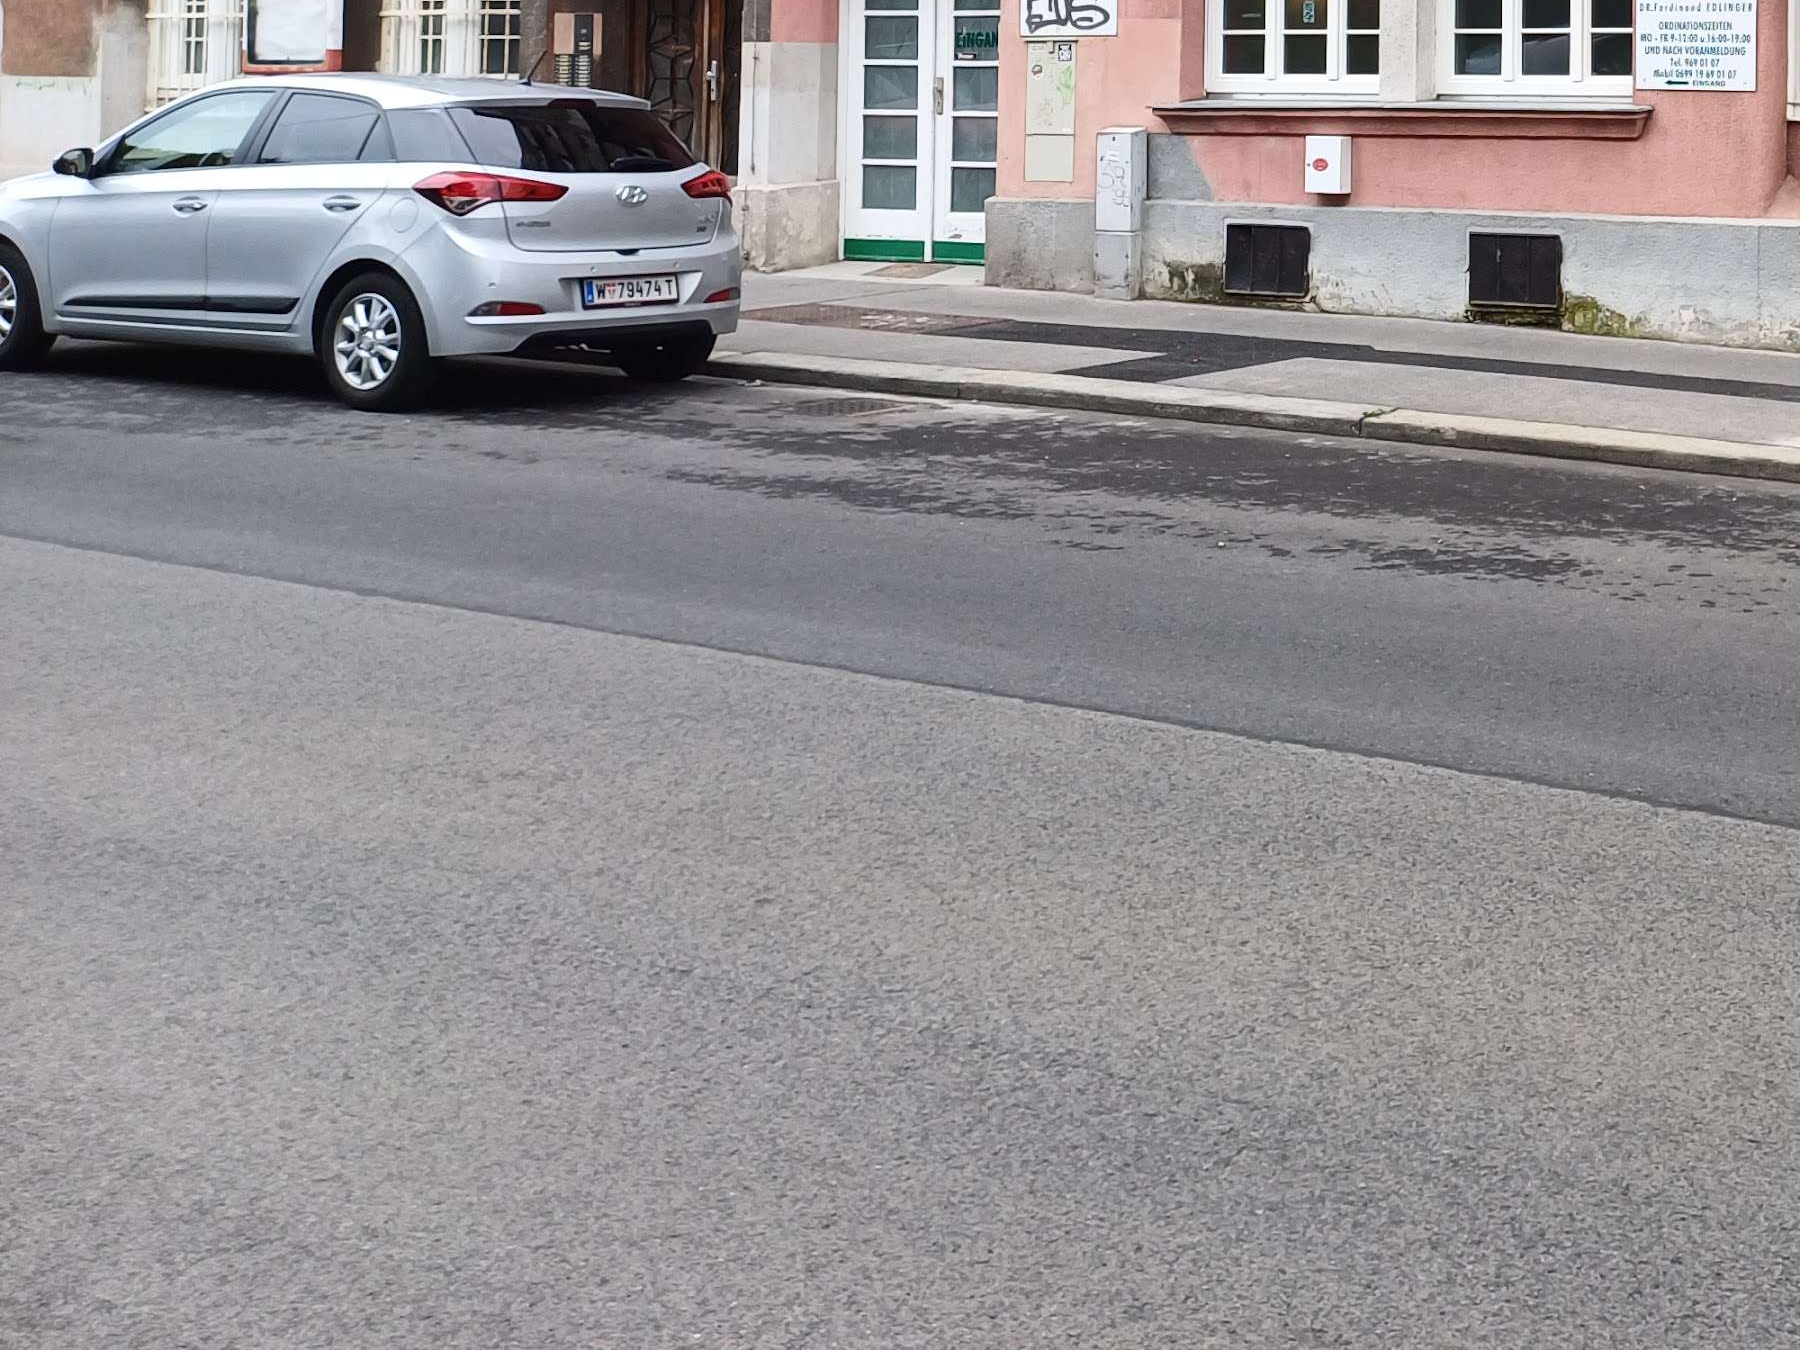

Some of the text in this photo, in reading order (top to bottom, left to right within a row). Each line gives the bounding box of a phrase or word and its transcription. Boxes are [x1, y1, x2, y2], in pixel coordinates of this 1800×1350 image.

[1706, 2, 1753, 12] EDLINGER
[1658, 21, 1733, 31] ORDINATIONSZEITEN
[957, 31, 997, 48] EINGAN
[1640, 34, 1652, 43] MO
[1660, 34, 1668, 43] FR
[1644, 46, 1746, 56] UND NACH VORANMELDUNG
[1685, 59, 1698, 67] 969
[1700, 59, 1708, 67] 01
[1710, 59, 1720, 68] 07
[1653, 69, 1673, 78] Mobil
[1695, 70, 1704, 78] 19
[1717, 70, 1725, 79] 01
[1727, 70, 1737, 79] 07
[595, 281, 606, 300] W
